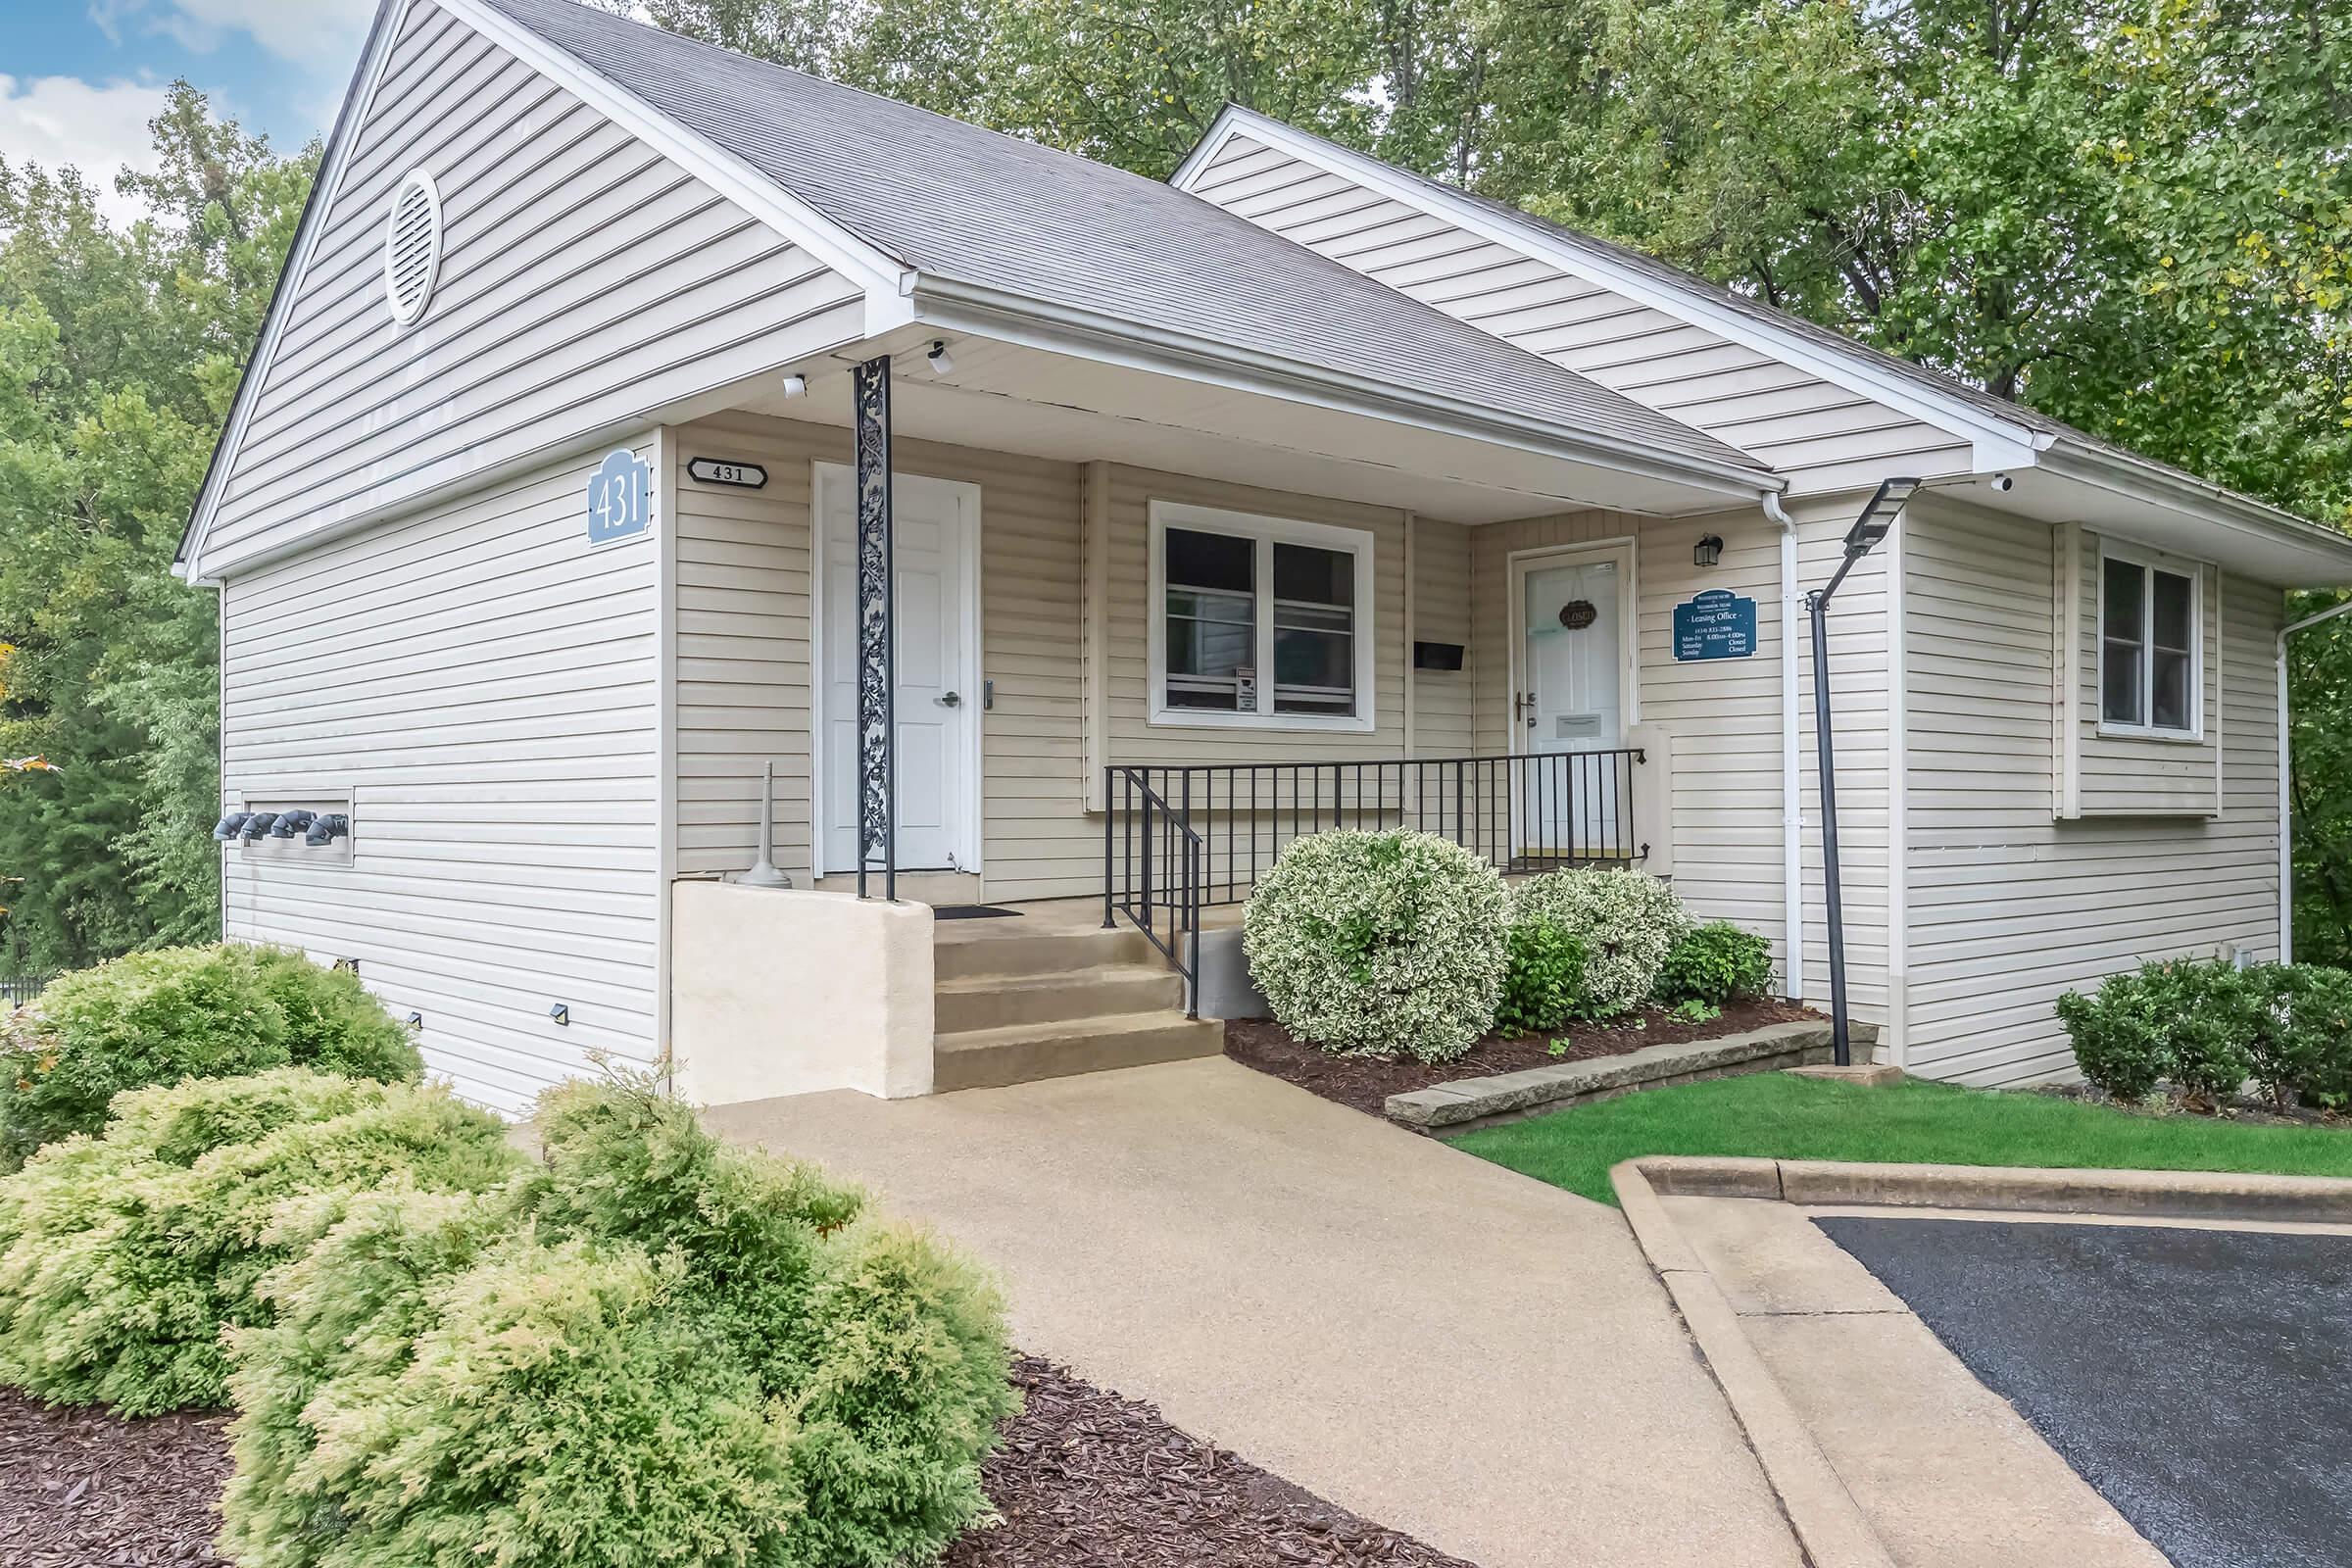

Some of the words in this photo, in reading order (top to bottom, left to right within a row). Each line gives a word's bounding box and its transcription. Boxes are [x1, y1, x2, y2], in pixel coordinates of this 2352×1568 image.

[712, 466, 744, 481] 431
[596, 469, 638, 529] 431
[1691, 614, 1715, 623] Leasing
